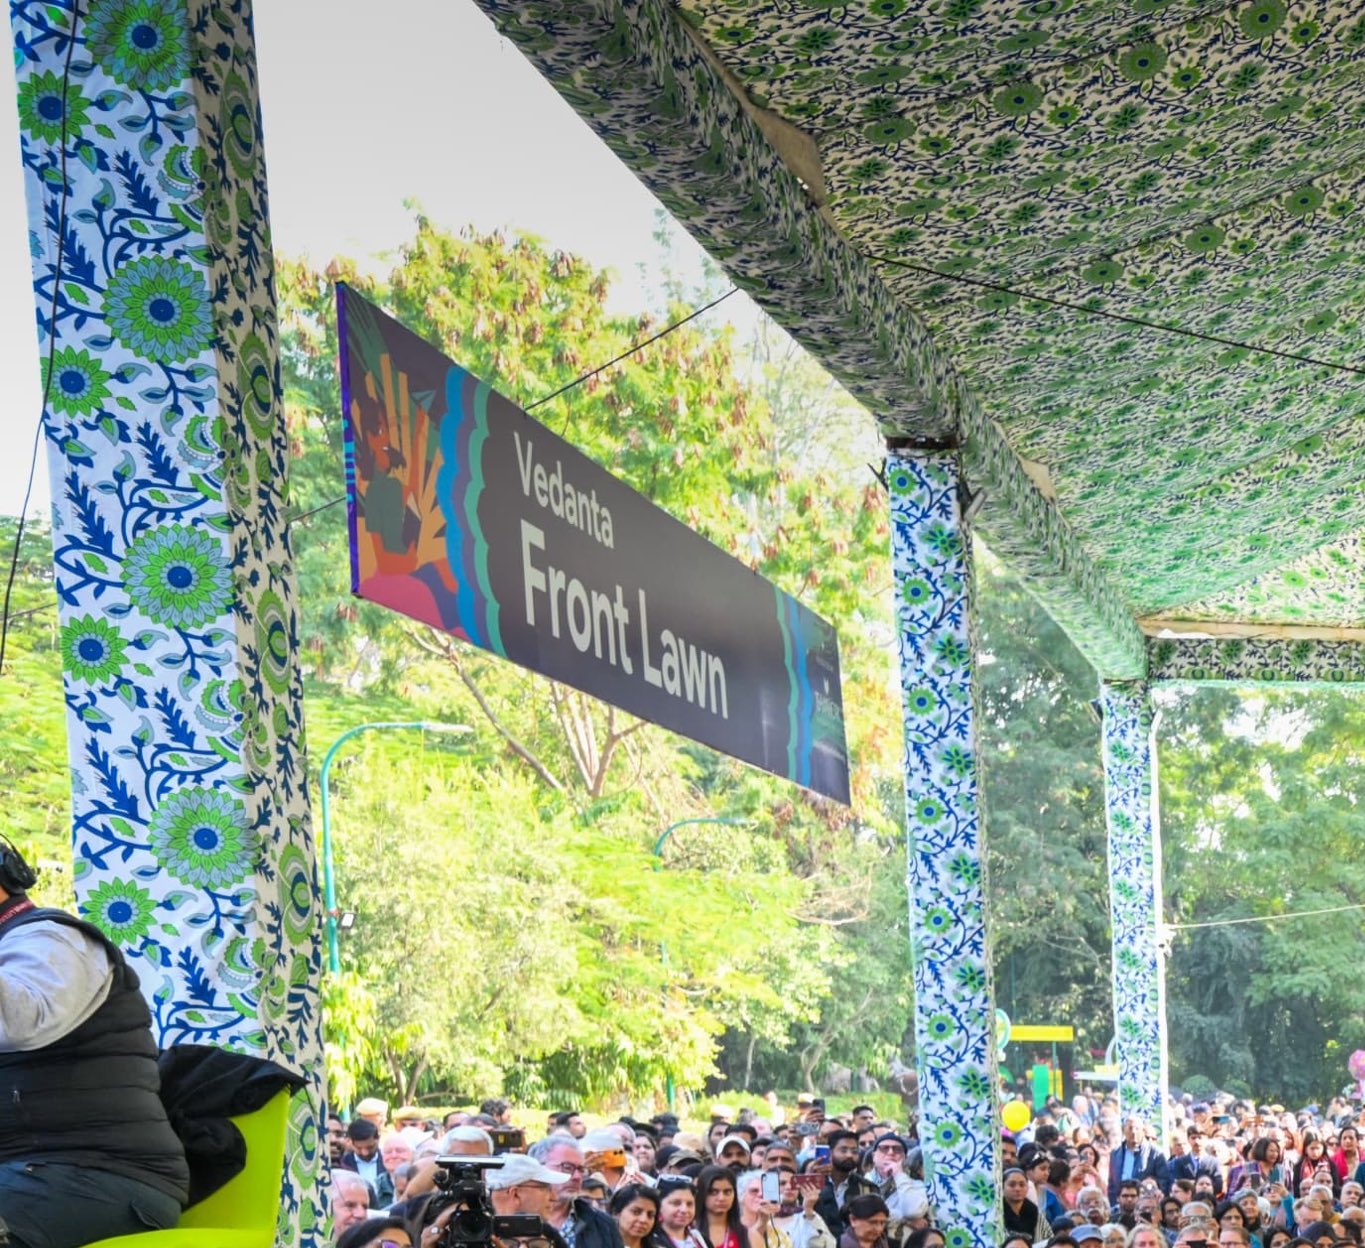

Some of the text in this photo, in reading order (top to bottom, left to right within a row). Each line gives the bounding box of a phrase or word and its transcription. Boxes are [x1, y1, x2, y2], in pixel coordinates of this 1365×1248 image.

[514, 431, 614, 549] Vedanta
[520, 518, 728, 719] Front Lawn
